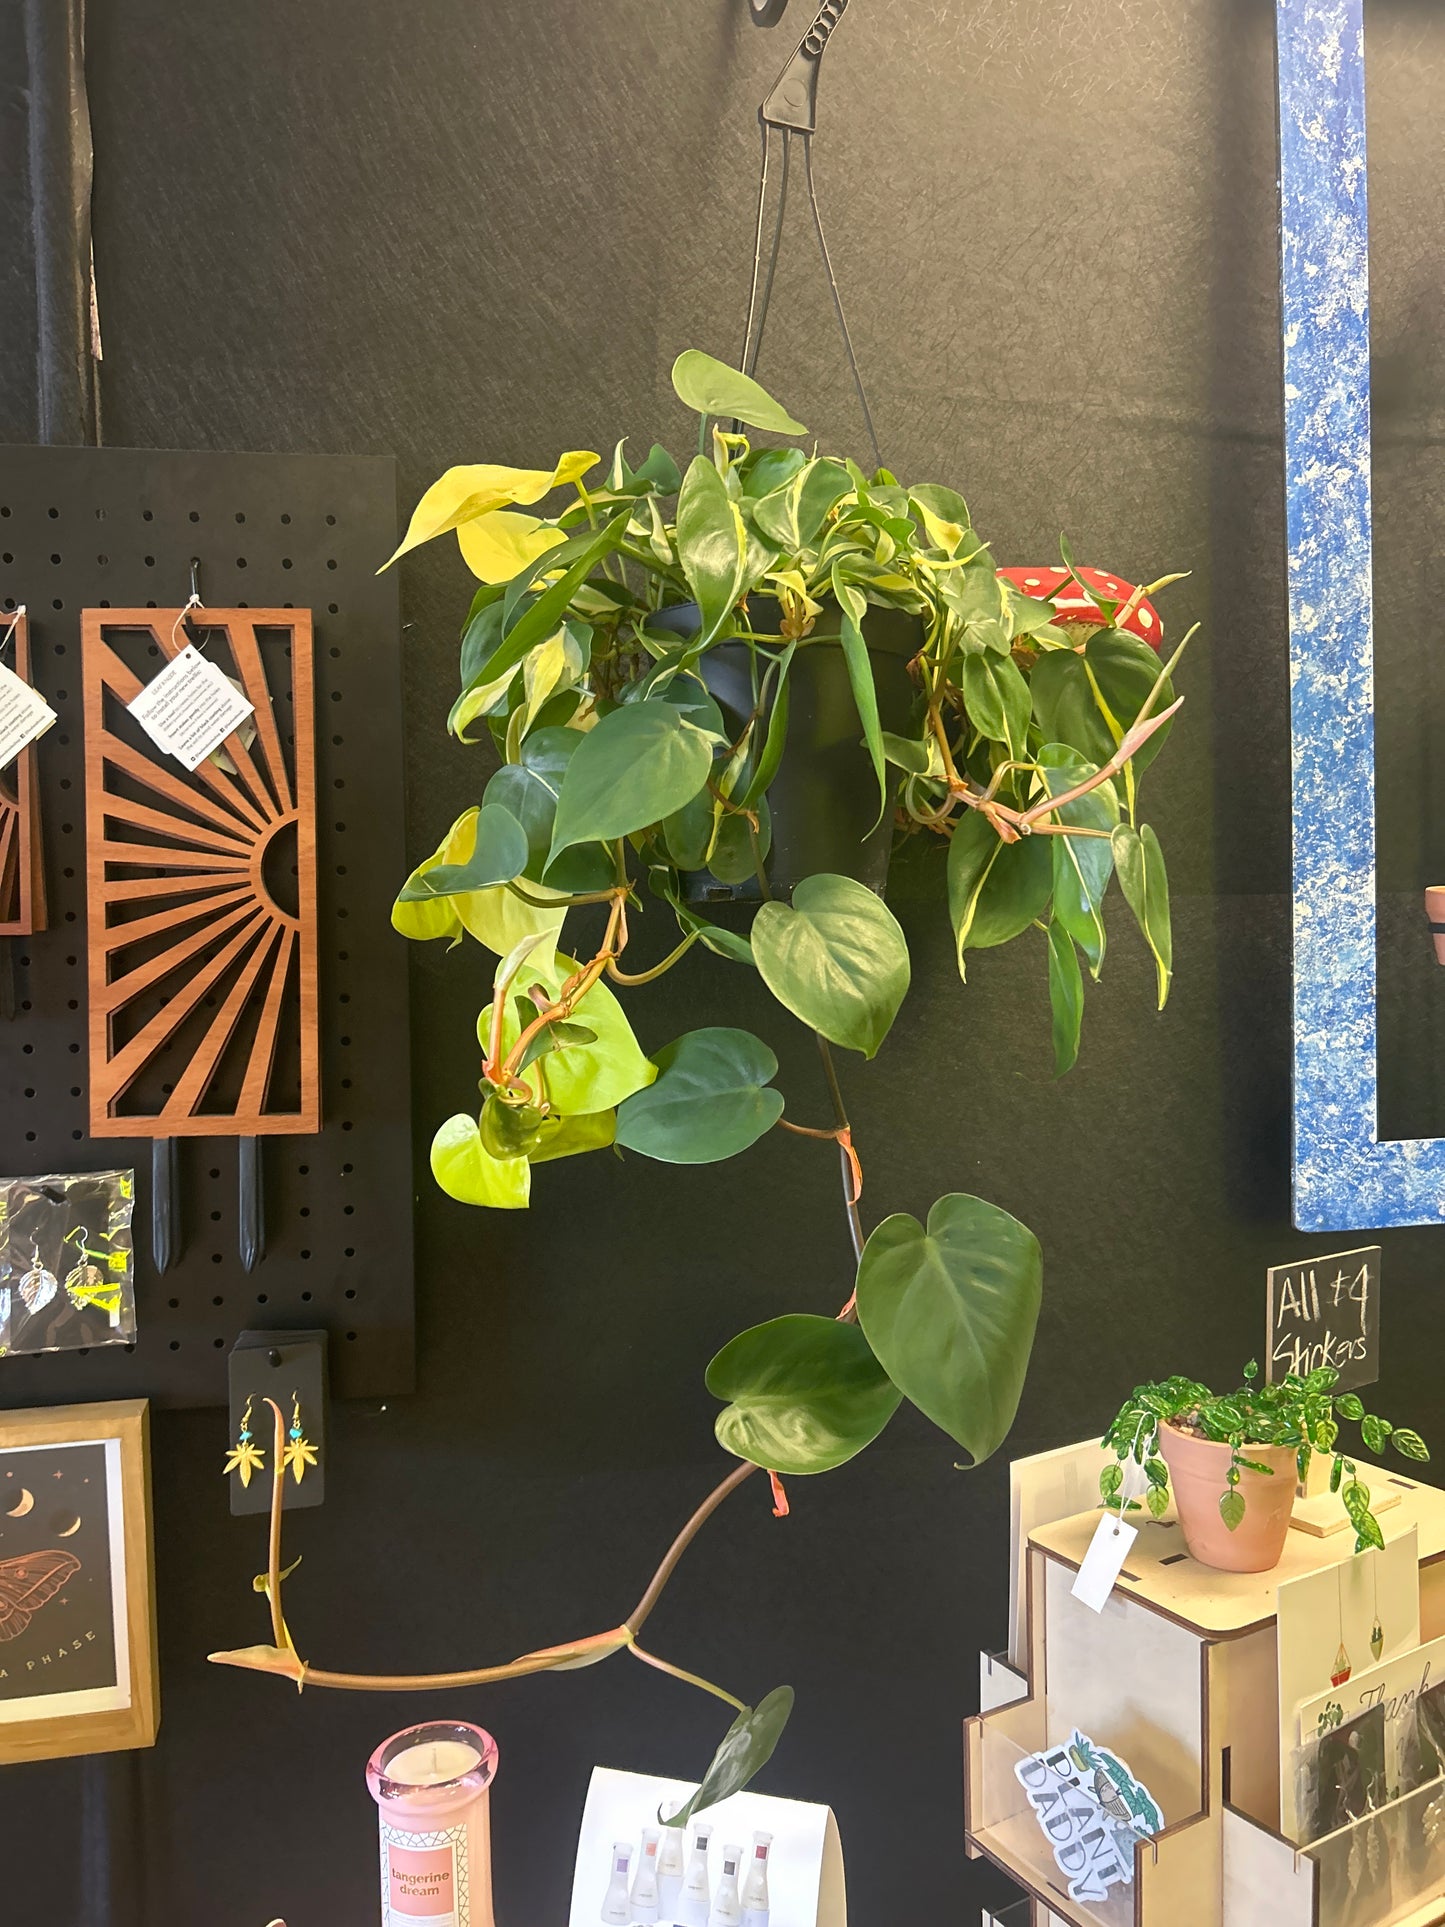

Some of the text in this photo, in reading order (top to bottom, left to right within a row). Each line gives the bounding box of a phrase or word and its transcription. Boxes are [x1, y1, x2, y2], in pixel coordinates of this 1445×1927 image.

[141, 659, 201, 720] Follow the instructions below
[155, 700, 170, 714] install
[168, 692, 180, 703] your
[178, 682, 188, 692] new
[188, 707, 200, 719] gently
[199, 718, 209, 728] black
[208, 707, 221, 721] coating
[1277, 1263, 1374, 1335] All $4
[1272, 1330, 1367, 1389] Stickers
[26, 1630, 96, 1671] PHASE
[1020, 1758, 1104, 1896] DADDY
[1046, 1751, 1127, 1880] PLANT
[392, 1867, 450, 1885] tangerine
[399, 1884, 440, 1896] dream
